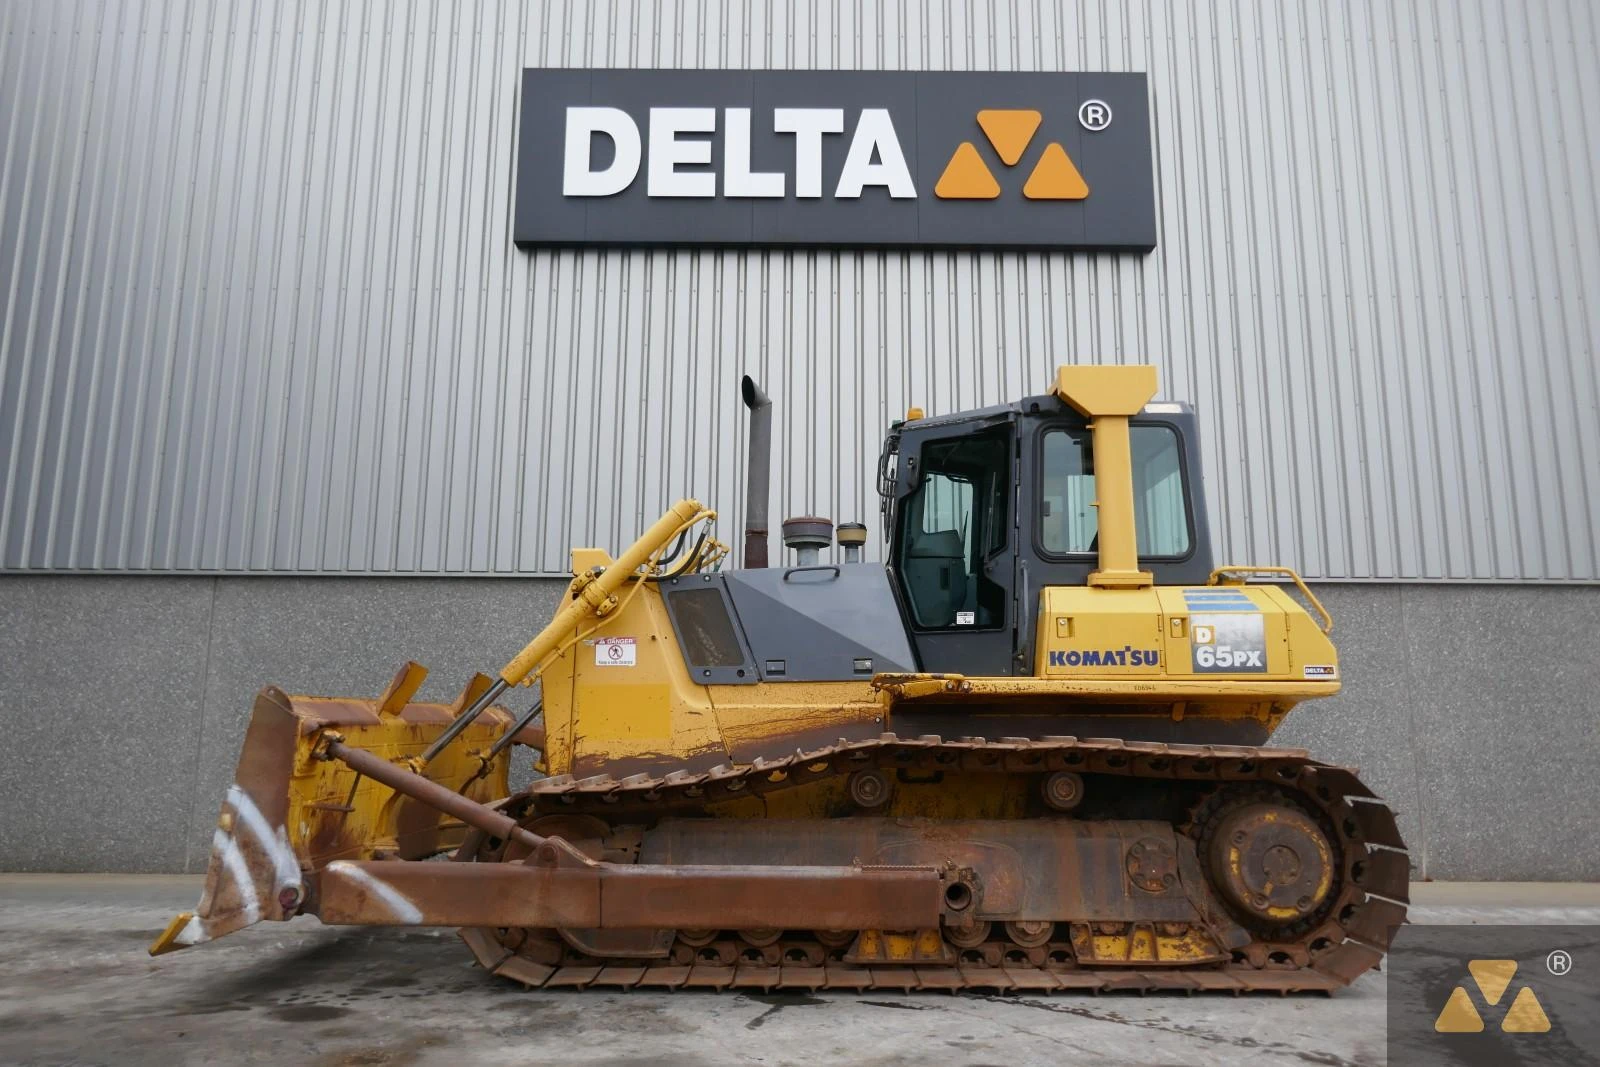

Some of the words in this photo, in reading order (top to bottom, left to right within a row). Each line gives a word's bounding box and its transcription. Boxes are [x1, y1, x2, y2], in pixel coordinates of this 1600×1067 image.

[563, 107, 917, 198] DELTA
[1196, 628, 1212, 643] D
[1049, 645, 1159, 666] KOMATSU
[1196, 645, 1263, 668] 65PX
